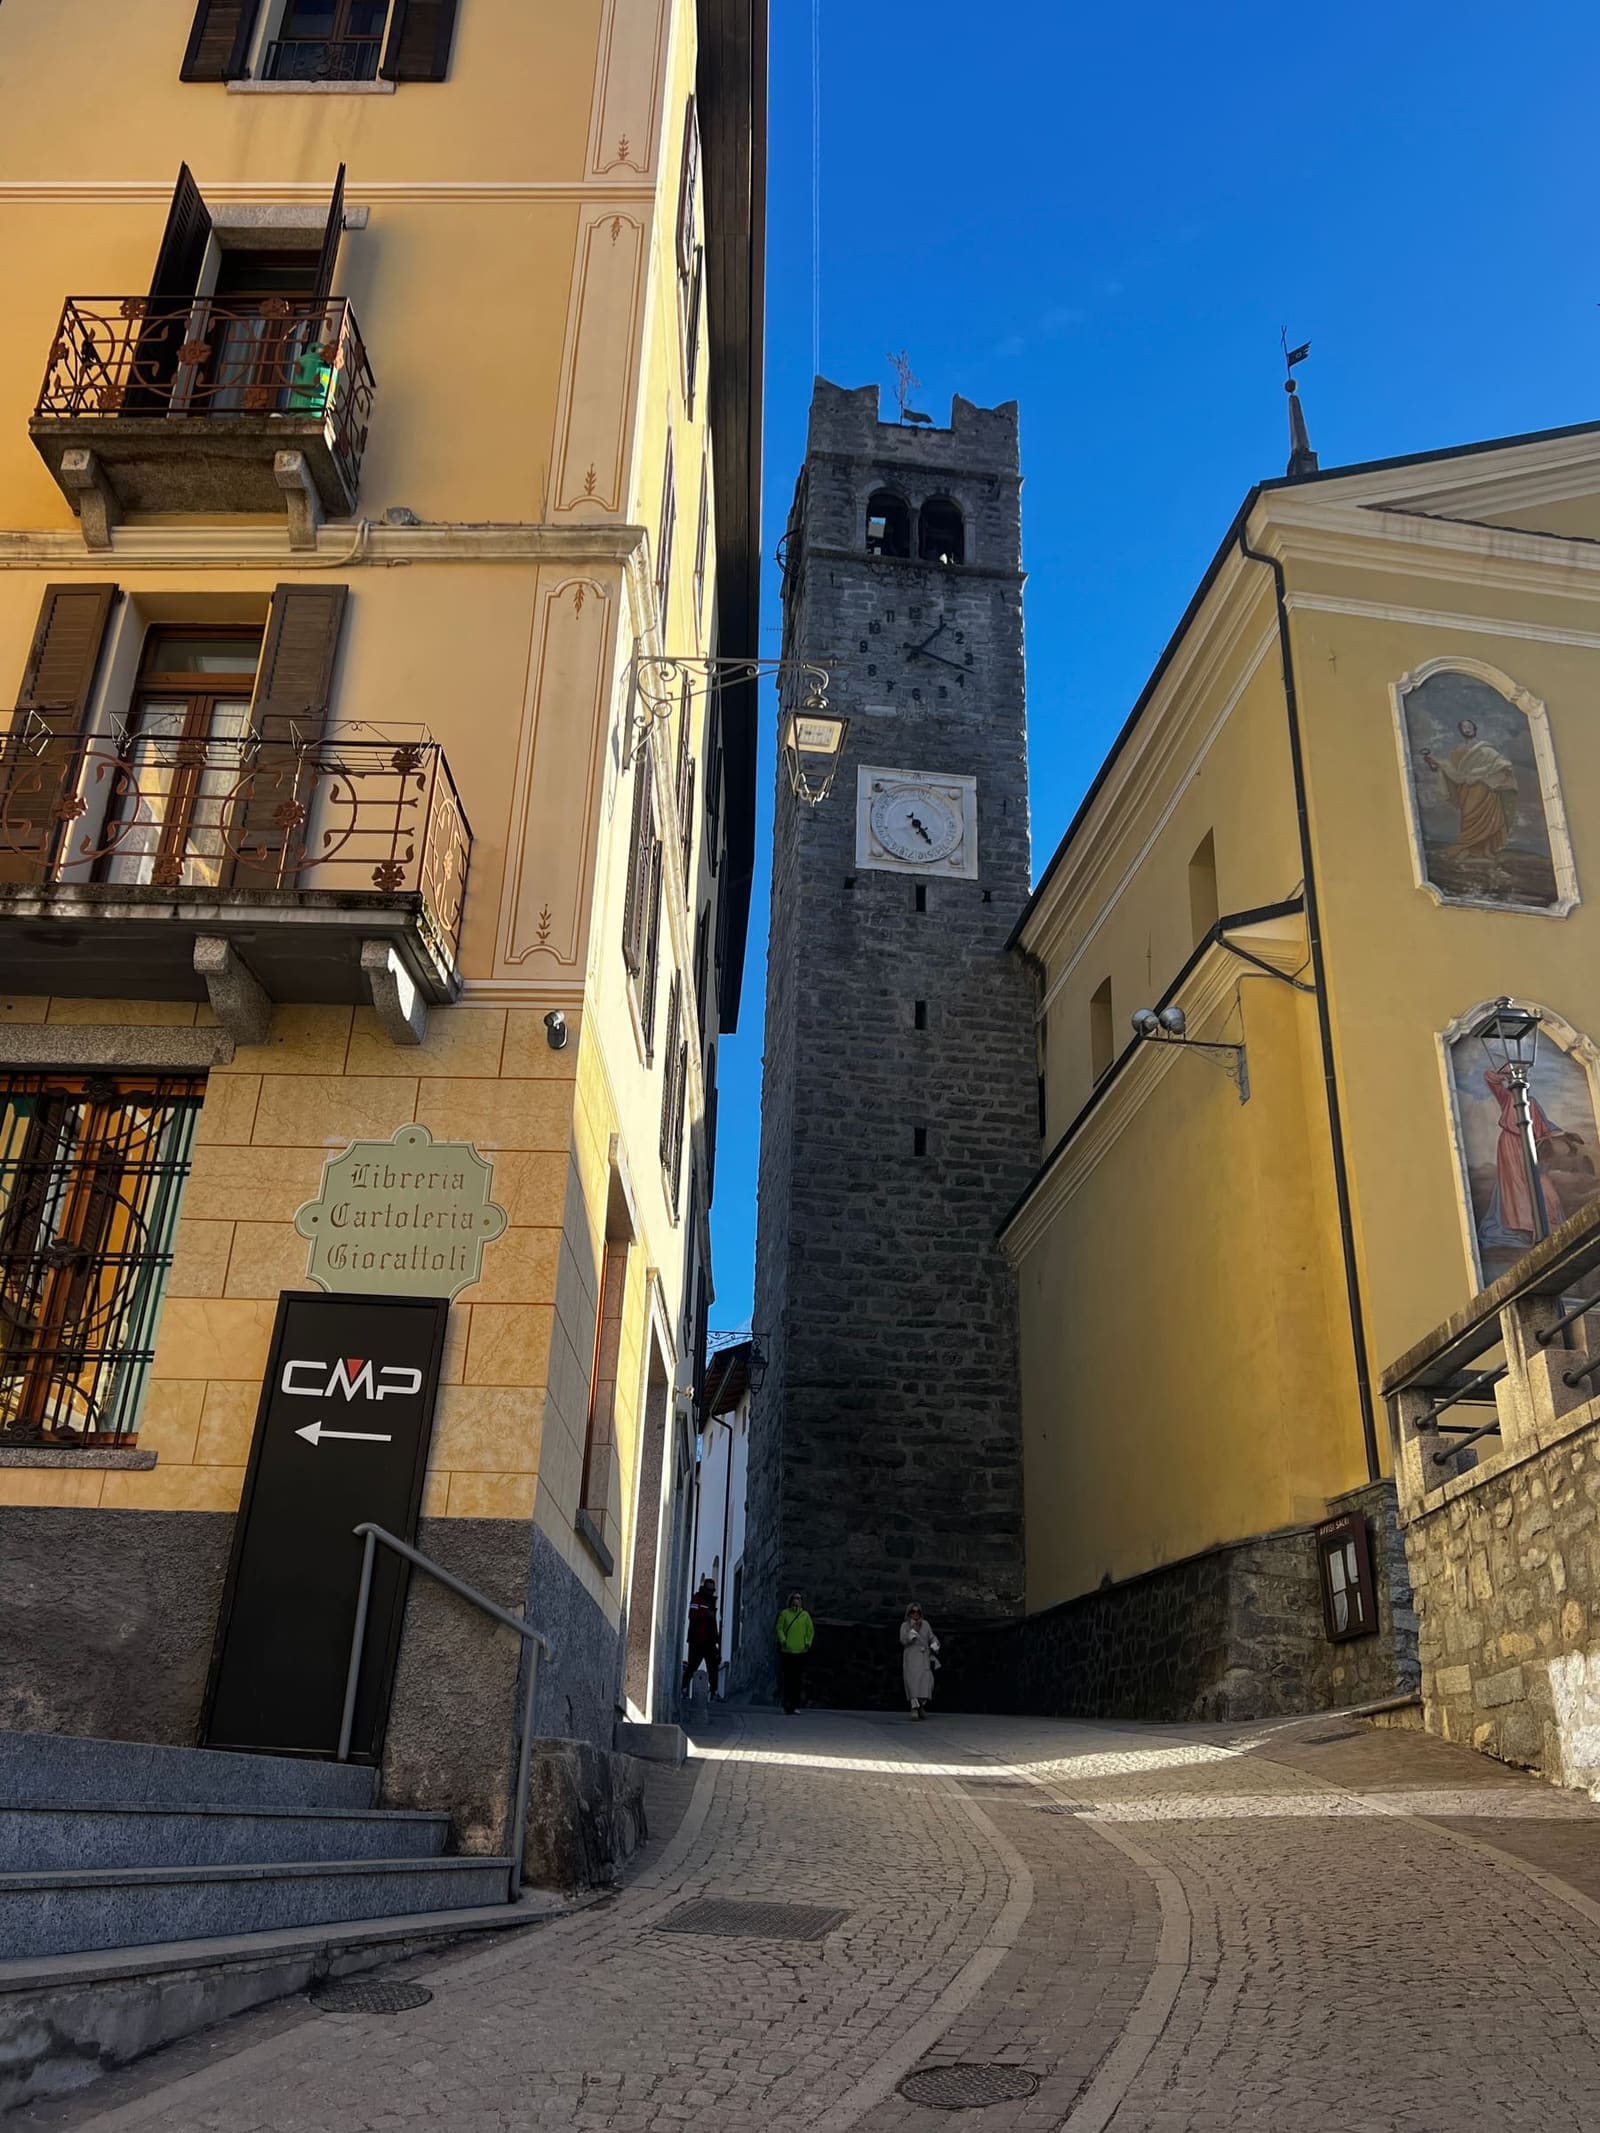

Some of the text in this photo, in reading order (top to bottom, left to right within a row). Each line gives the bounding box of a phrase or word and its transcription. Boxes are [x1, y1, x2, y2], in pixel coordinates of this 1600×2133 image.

[955, 631, 965, 645] 2
[859, 640, 869, 654] 9
[867, 664, 877, 677] 8
[954, 673, 965, 688] 4
[911, 687, 921, 701] 6
[350, 1163, 466, 1190] Libreria
[329, 1202, 474, 1230] Cartoleria
[327, 1243, 468, 1272] Giocattoli
[281, 1357, 423, 1402] CMP
